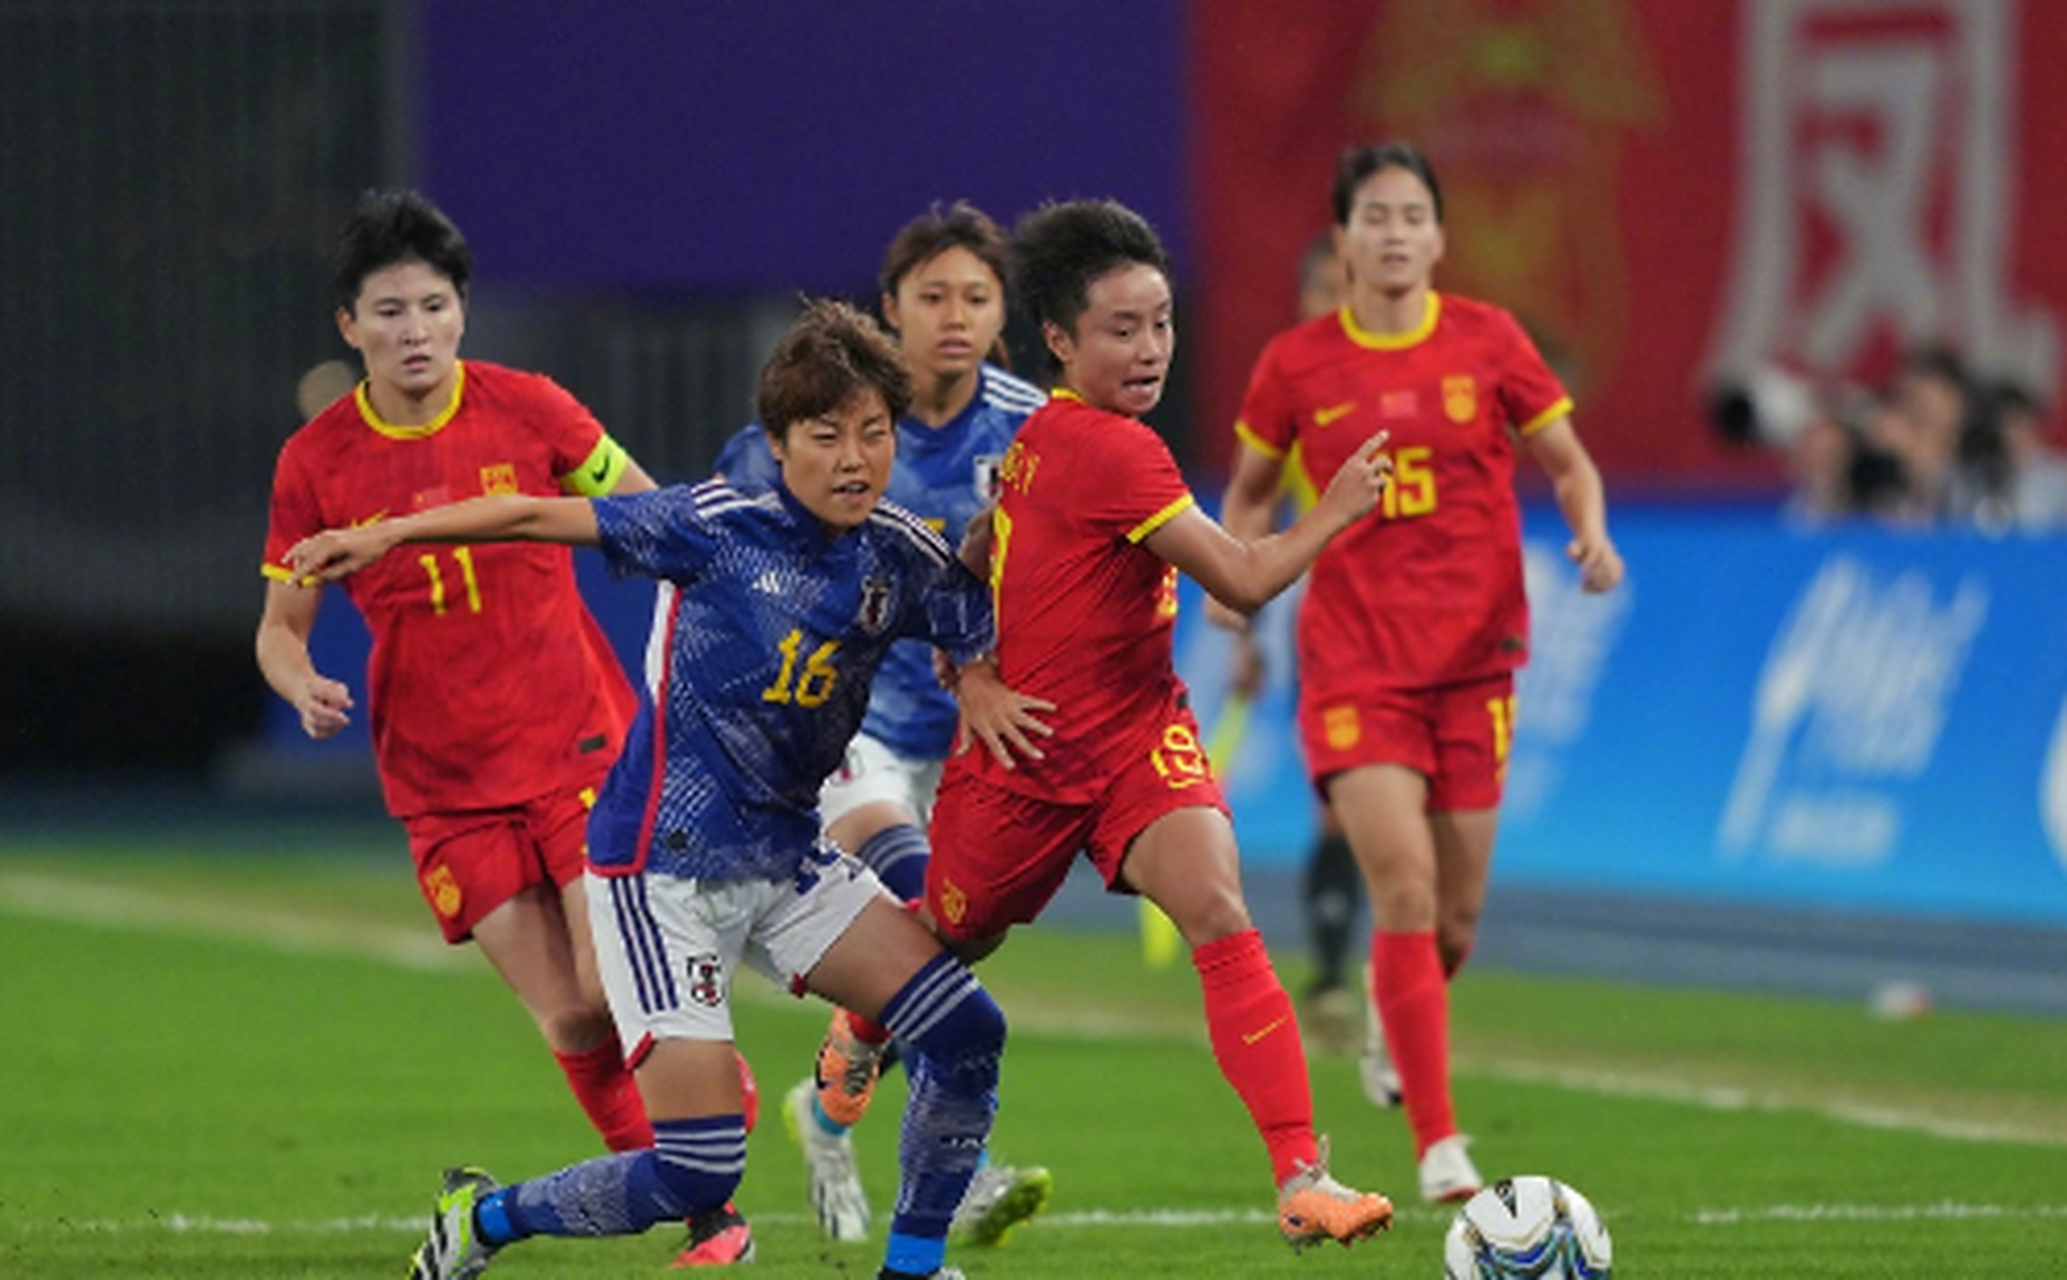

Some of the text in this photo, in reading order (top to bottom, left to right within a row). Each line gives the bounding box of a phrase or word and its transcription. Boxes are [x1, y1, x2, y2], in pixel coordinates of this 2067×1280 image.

[1378, 447, 1436, 519] 15
[419, 545, 482, 616] 11
[762, 628, 841, 709] 16
[1150, 724, 1206, 776] 19
